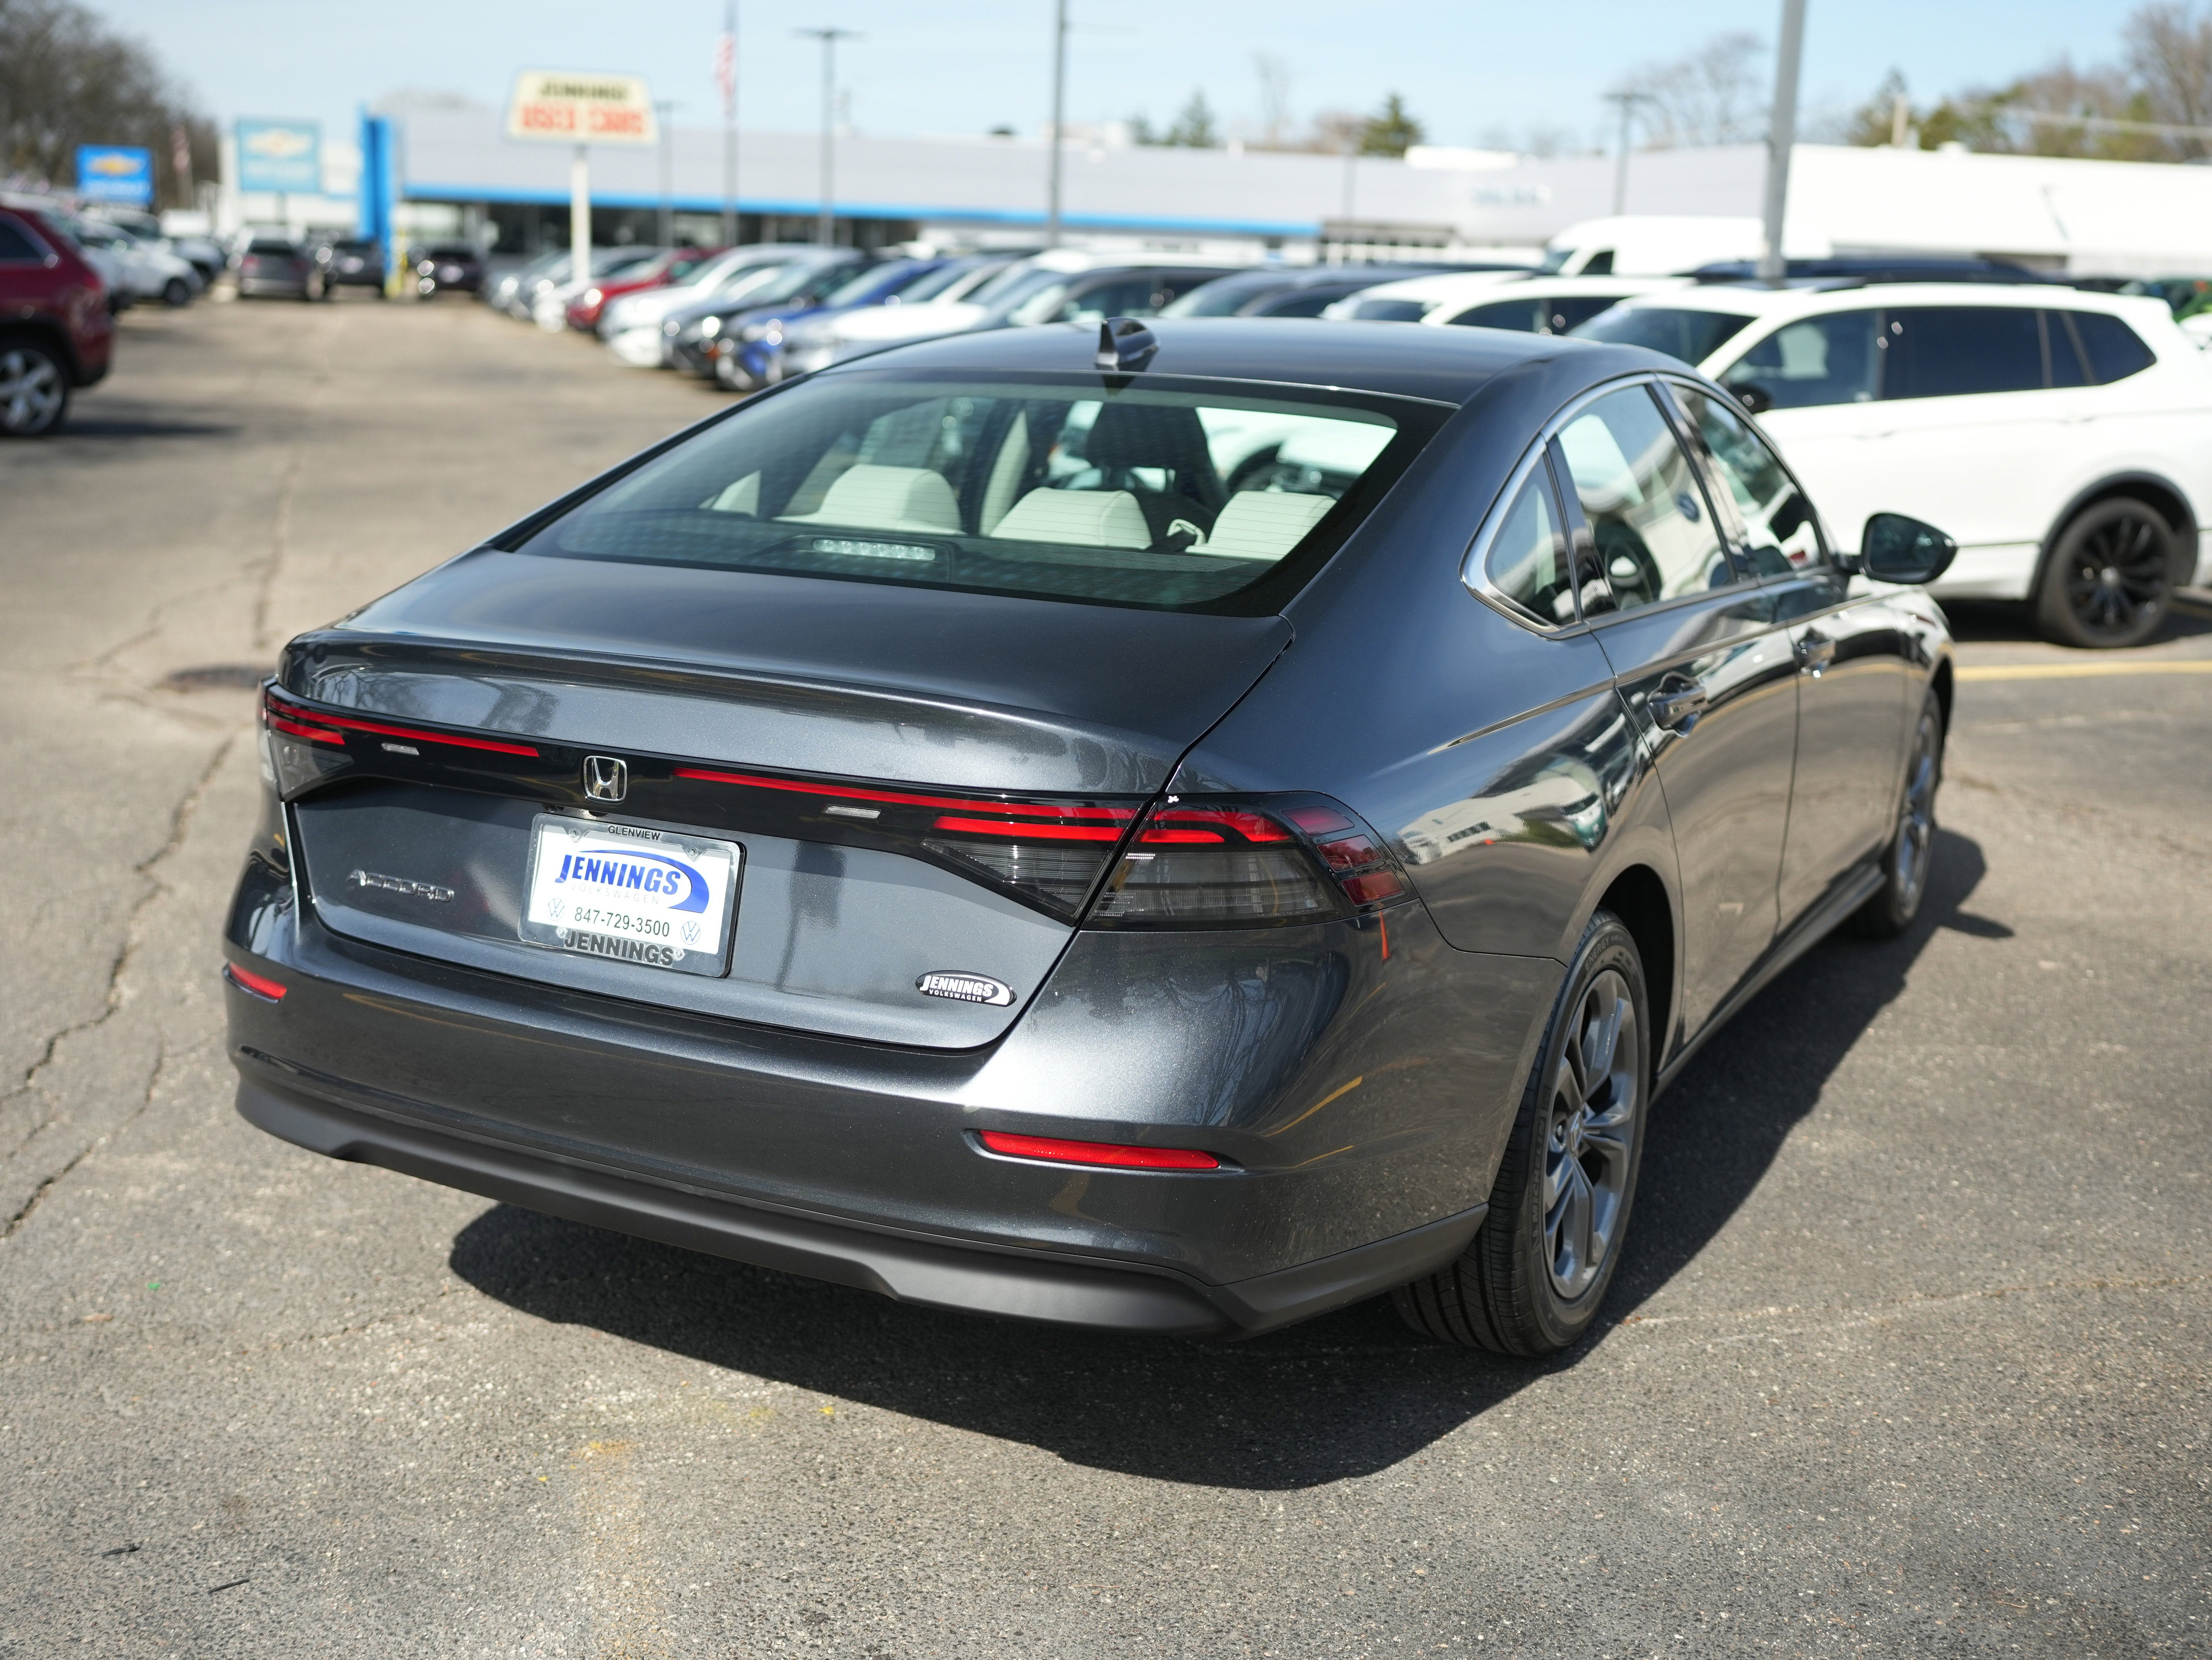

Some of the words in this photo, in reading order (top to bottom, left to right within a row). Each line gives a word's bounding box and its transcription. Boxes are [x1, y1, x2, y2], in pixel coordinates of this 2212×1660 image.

[608, 825, 660, 840] GLENVIEW
[347, 870, 454, 902] ACCORD
[555, 855, 681, 895] JENNINGS
[571, 882, 659, 905] VOLKSWAGEN
[575, 907, 670, 937] 847-729-3500
[564, 930, 673, 966] JENNINGS
[1585, 935, 1609, 971] ENERGY
[919, 975, 994, 997] JENNINGS
[929, 989, 982, 1002] VOLKSWAGEN
[1532, 1117, 1547, 1223] MICHELIN
